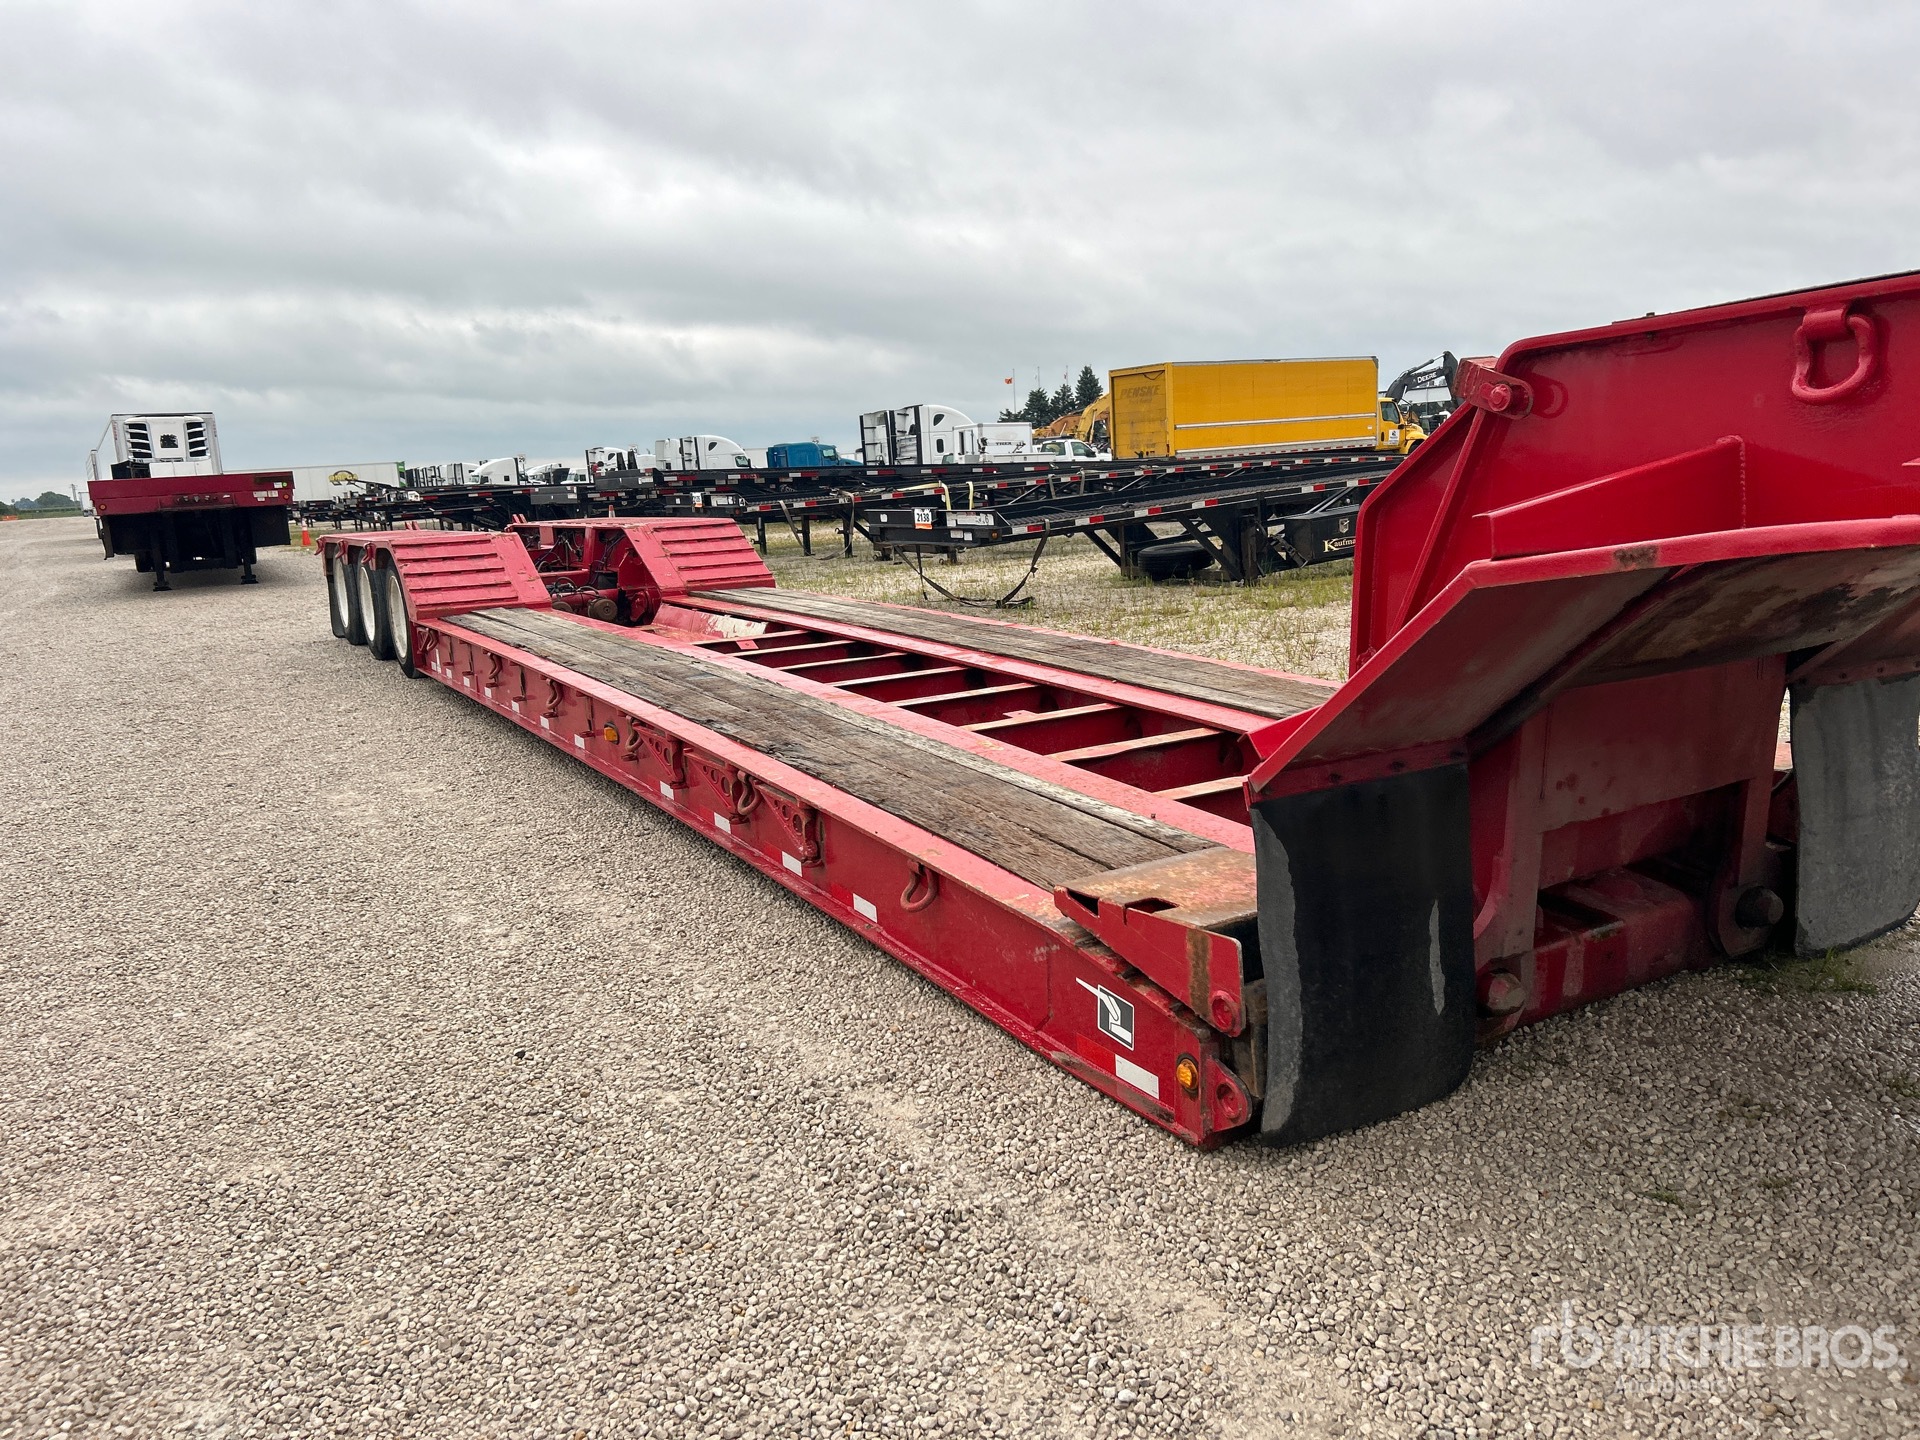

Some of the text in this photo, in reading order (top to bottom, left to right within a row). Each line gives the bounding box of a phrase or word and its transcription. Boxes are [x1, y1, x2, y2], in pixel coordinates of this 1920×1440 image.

[1417, 372, 1438, 383] DEERE
[1120, 385, 1161, 399] PENSKE
[916, 512, 931, 522] 2138
